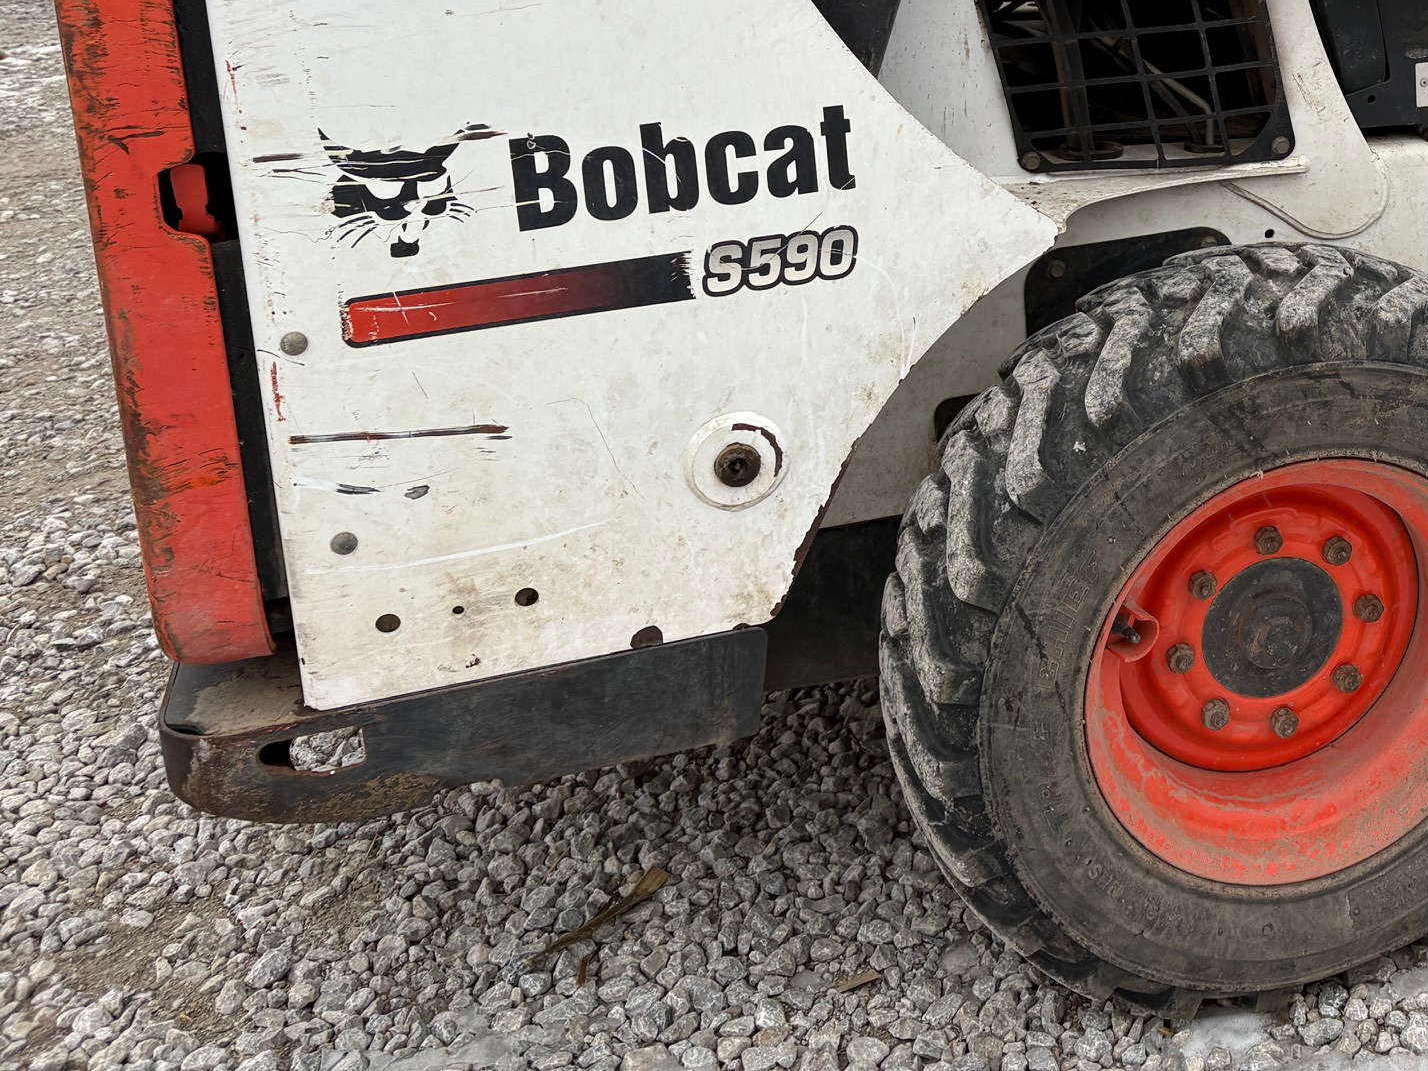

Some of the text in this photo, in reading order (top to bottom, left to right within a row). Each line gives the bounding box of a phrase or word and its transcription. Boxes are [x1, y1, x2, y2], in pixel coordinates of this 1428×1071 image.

[508, 104, 858, 232] Bobcat
[702, 224, 859, 298] S590
[1031, 547, 1109, 692] CHIEF
